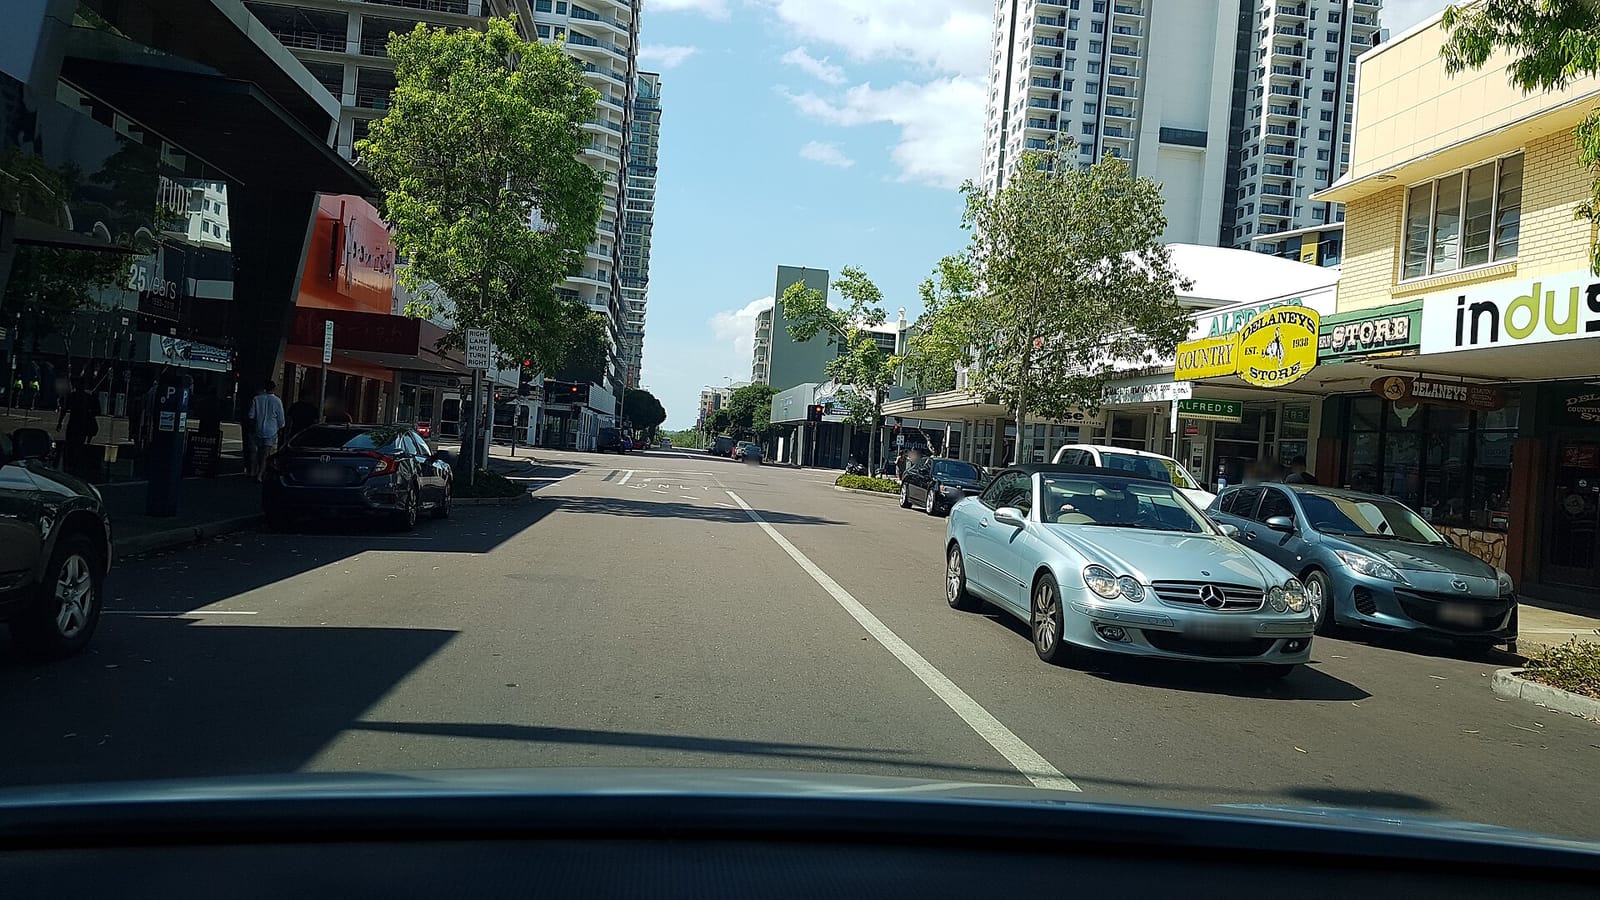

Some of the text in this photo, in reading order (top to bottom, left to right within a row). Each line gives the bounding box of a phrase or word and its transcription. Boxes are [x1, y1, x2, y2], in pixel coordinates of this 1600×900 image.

[128, 263, 177, 300] 25 years
[1241, 311, 1316, 343] DELANEYS
[1332, 316, 1410, 351] STORE
[1177, 342, 1236, 371] COUNTRY
[1244, 337, 1309, 356] EST. 1938
[1249, 361, 1301, 381] STORE
[166, 386, 177, 399] P
[1412, 381, 1468, 401] DELANEYS
[1178, 401, 1233, 413] ALFRED'S
[635, 483, 711, 491] ONLY
